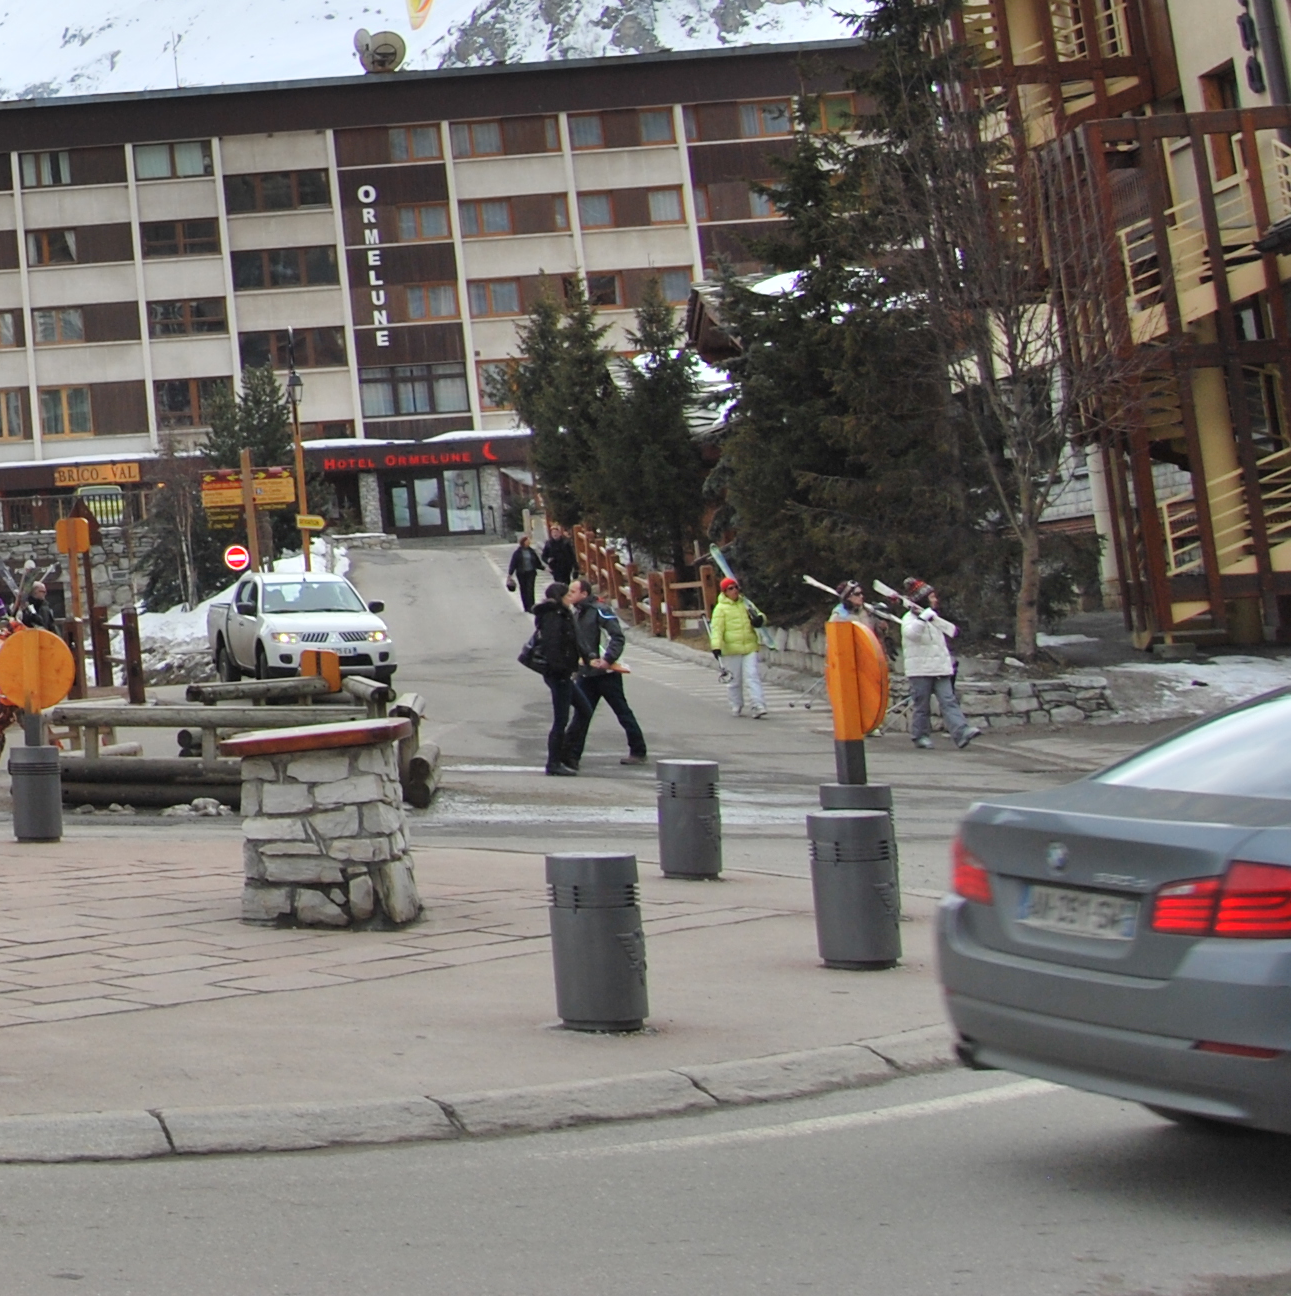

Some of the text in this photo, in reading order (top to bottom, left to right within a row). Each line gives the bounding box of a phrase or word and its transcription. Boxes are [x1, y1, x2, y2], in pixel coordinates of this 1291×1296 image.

[357, 185, 389, 346] ORMELUNE
[324, 452, 471, 470] HOTEL ORMELUNE
[58, 468, 99, 482] BRICO
[111, 465, 136, 479] VAL
